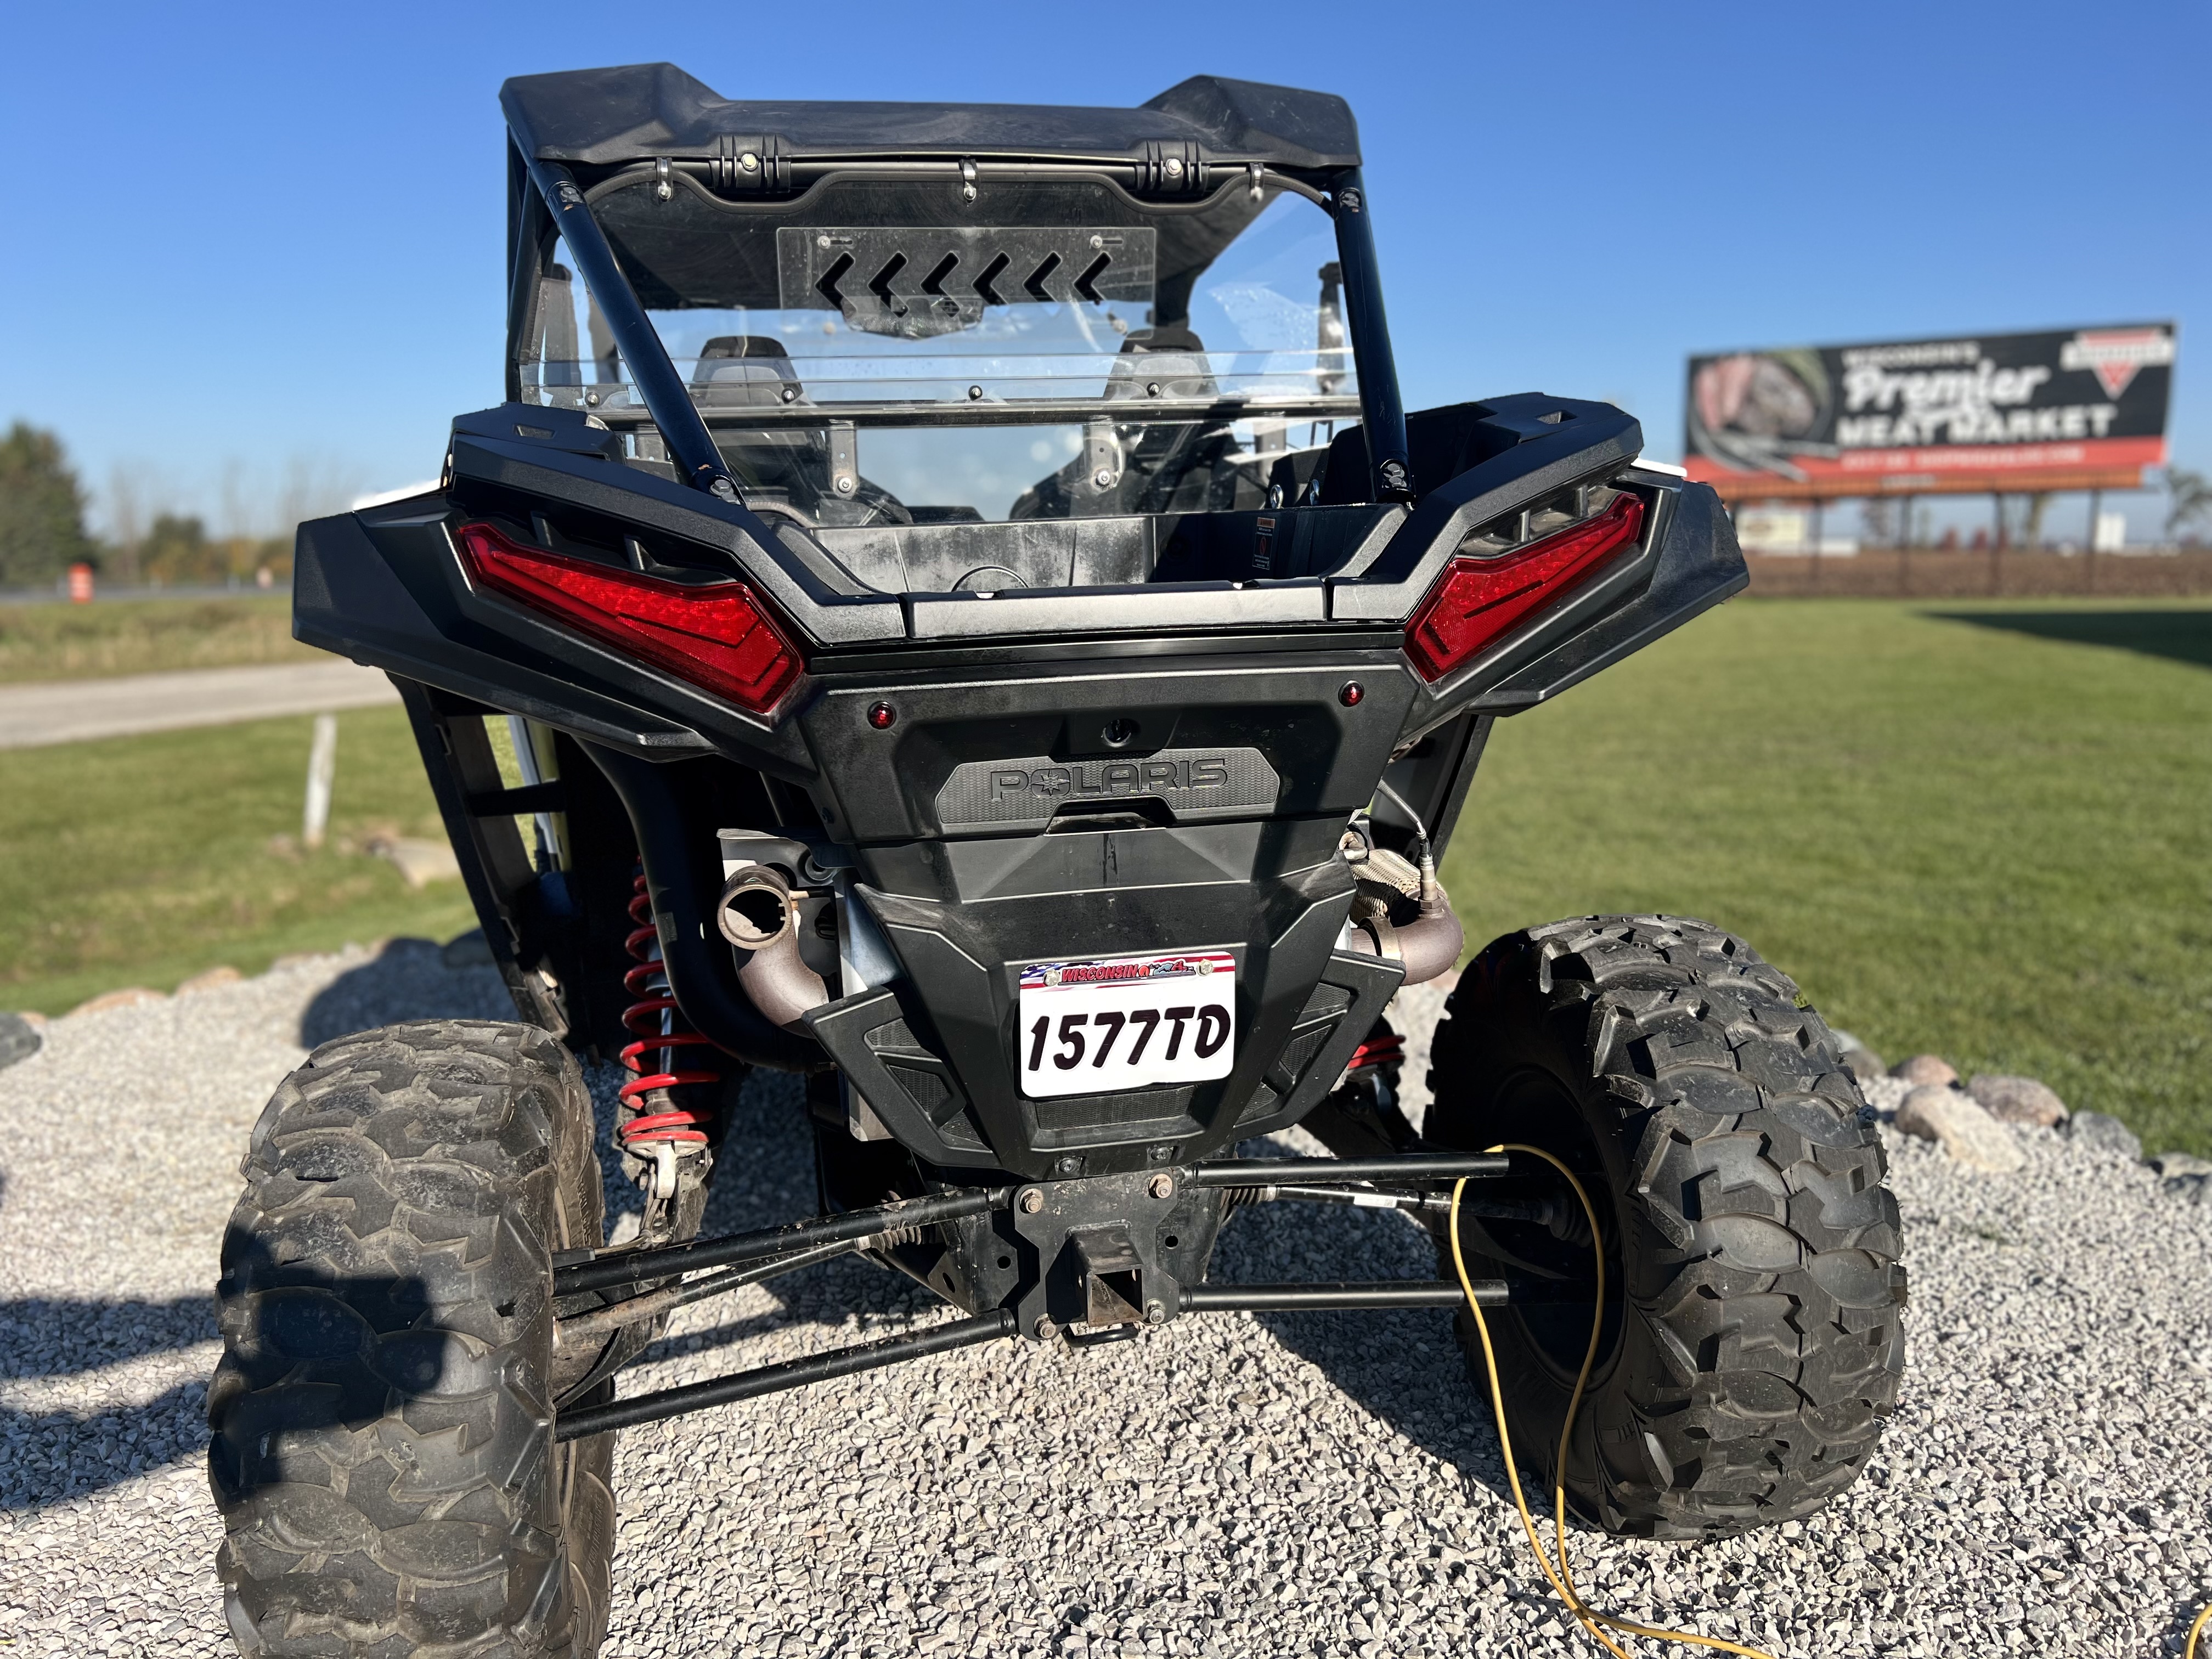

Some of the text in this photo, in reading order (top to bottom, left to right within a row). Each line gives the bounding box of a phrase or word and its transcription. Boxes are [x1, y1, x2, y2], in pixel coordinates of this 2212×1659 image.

[1843, 358, 2050, 411] Premier
[1836, 403, 2118, 448] MEAT MARKET
[991, 758, 1228, 801] POLARIS
[1061, 964, 1139, 983] WISCONSIN
[1028, 1004, 1231, 1072] 1577TD
